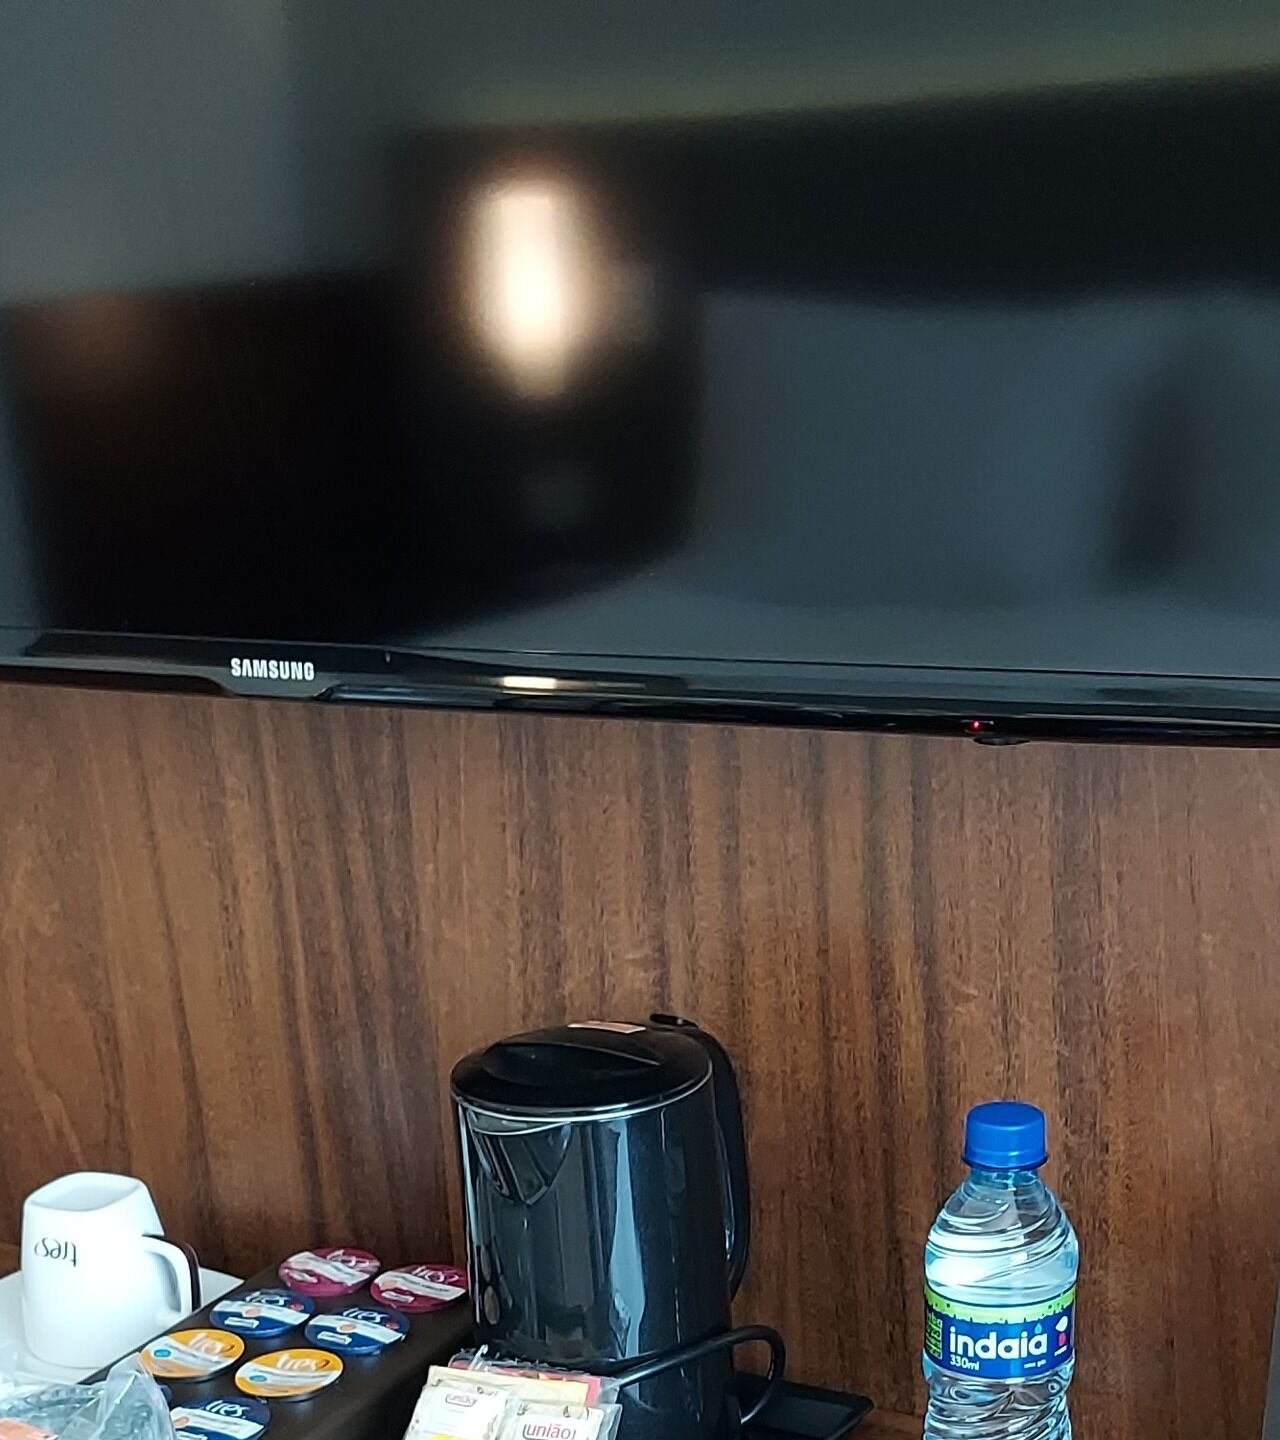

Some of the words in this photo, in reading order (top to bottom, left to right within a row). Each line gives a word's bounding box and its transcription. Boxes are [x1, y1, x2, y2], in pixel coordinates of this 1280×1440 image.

[230, 657, 315, 682] SAMSUNG
[949, 1353, 980, 1371] 330ml
[526, 1423, 571, 1440] união
